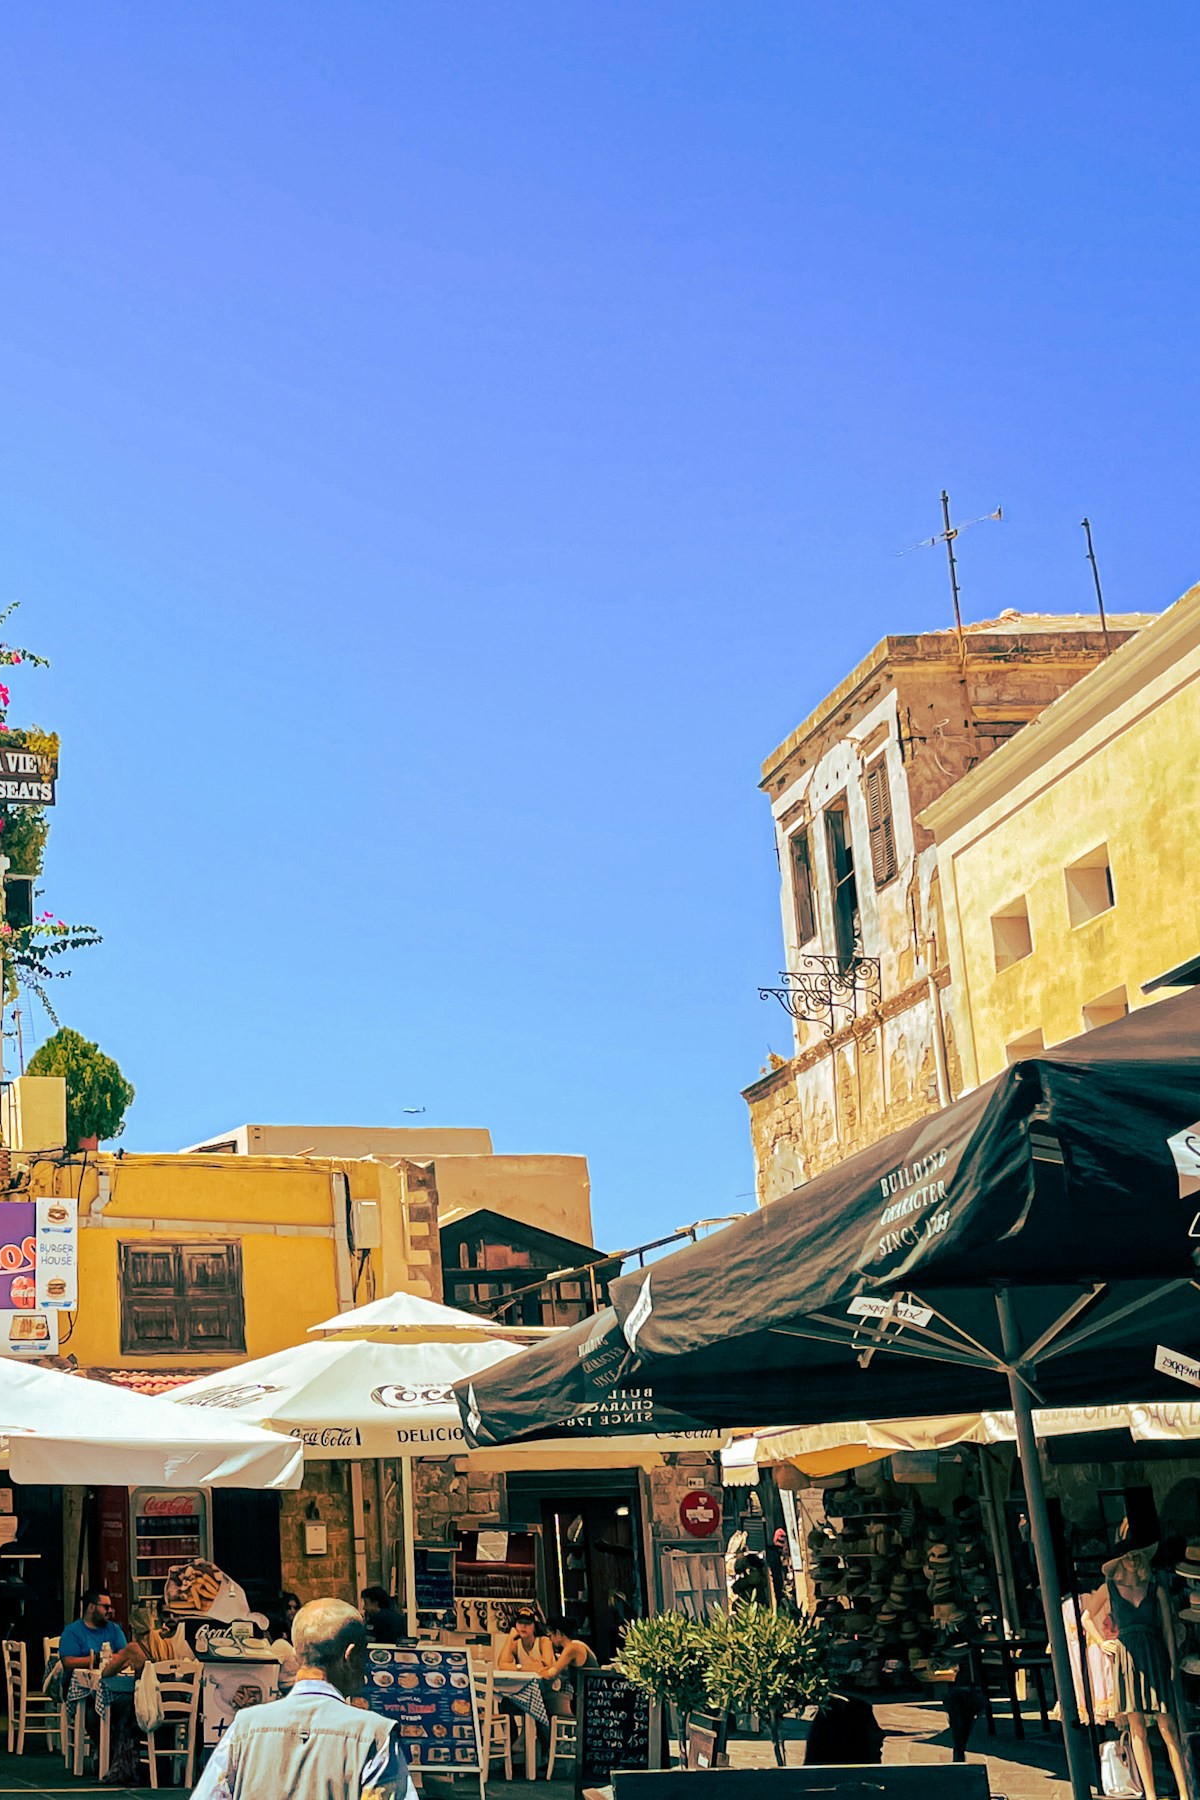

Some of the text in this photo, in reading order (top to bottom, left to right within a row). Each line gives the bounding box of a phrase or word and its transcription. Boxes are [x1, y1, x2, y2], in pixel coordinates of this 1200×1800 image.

[880, 1147, 948, 1198] BUILDING
[880, 1180, 949, 1226] CHARACTER
[40, 1243, 74, 1254] BURGER
[879, 1224, 921, 1257] SINCE
[40, 1256, 72, 1266] HOUSE
[396, 1426, 465, 1443] DELICIO
